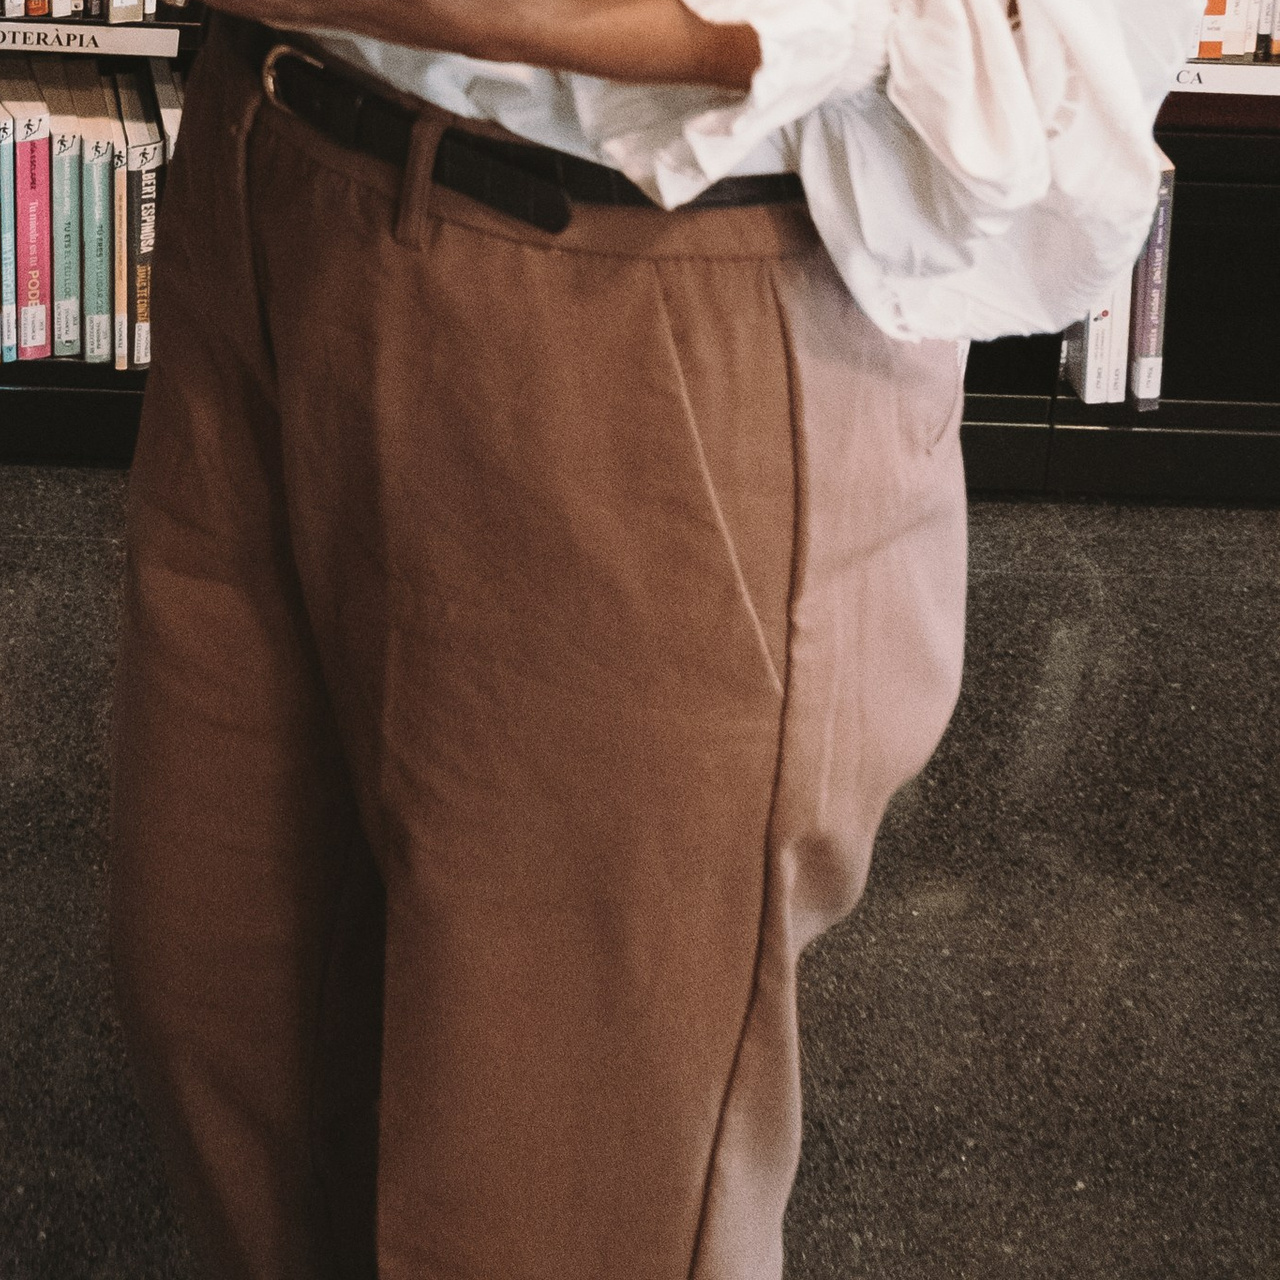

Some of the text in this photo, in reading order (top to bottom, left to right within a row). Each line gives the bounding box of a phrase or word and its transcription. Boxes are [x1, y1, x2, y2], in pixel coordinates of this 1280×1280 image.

[29, 153, 37, 190] ESCLAPEZ
[64, 221, 71, 233] TU
[139, 202, 157, 254] ESPINOSA
[96, 234, 104, 258] ERES
